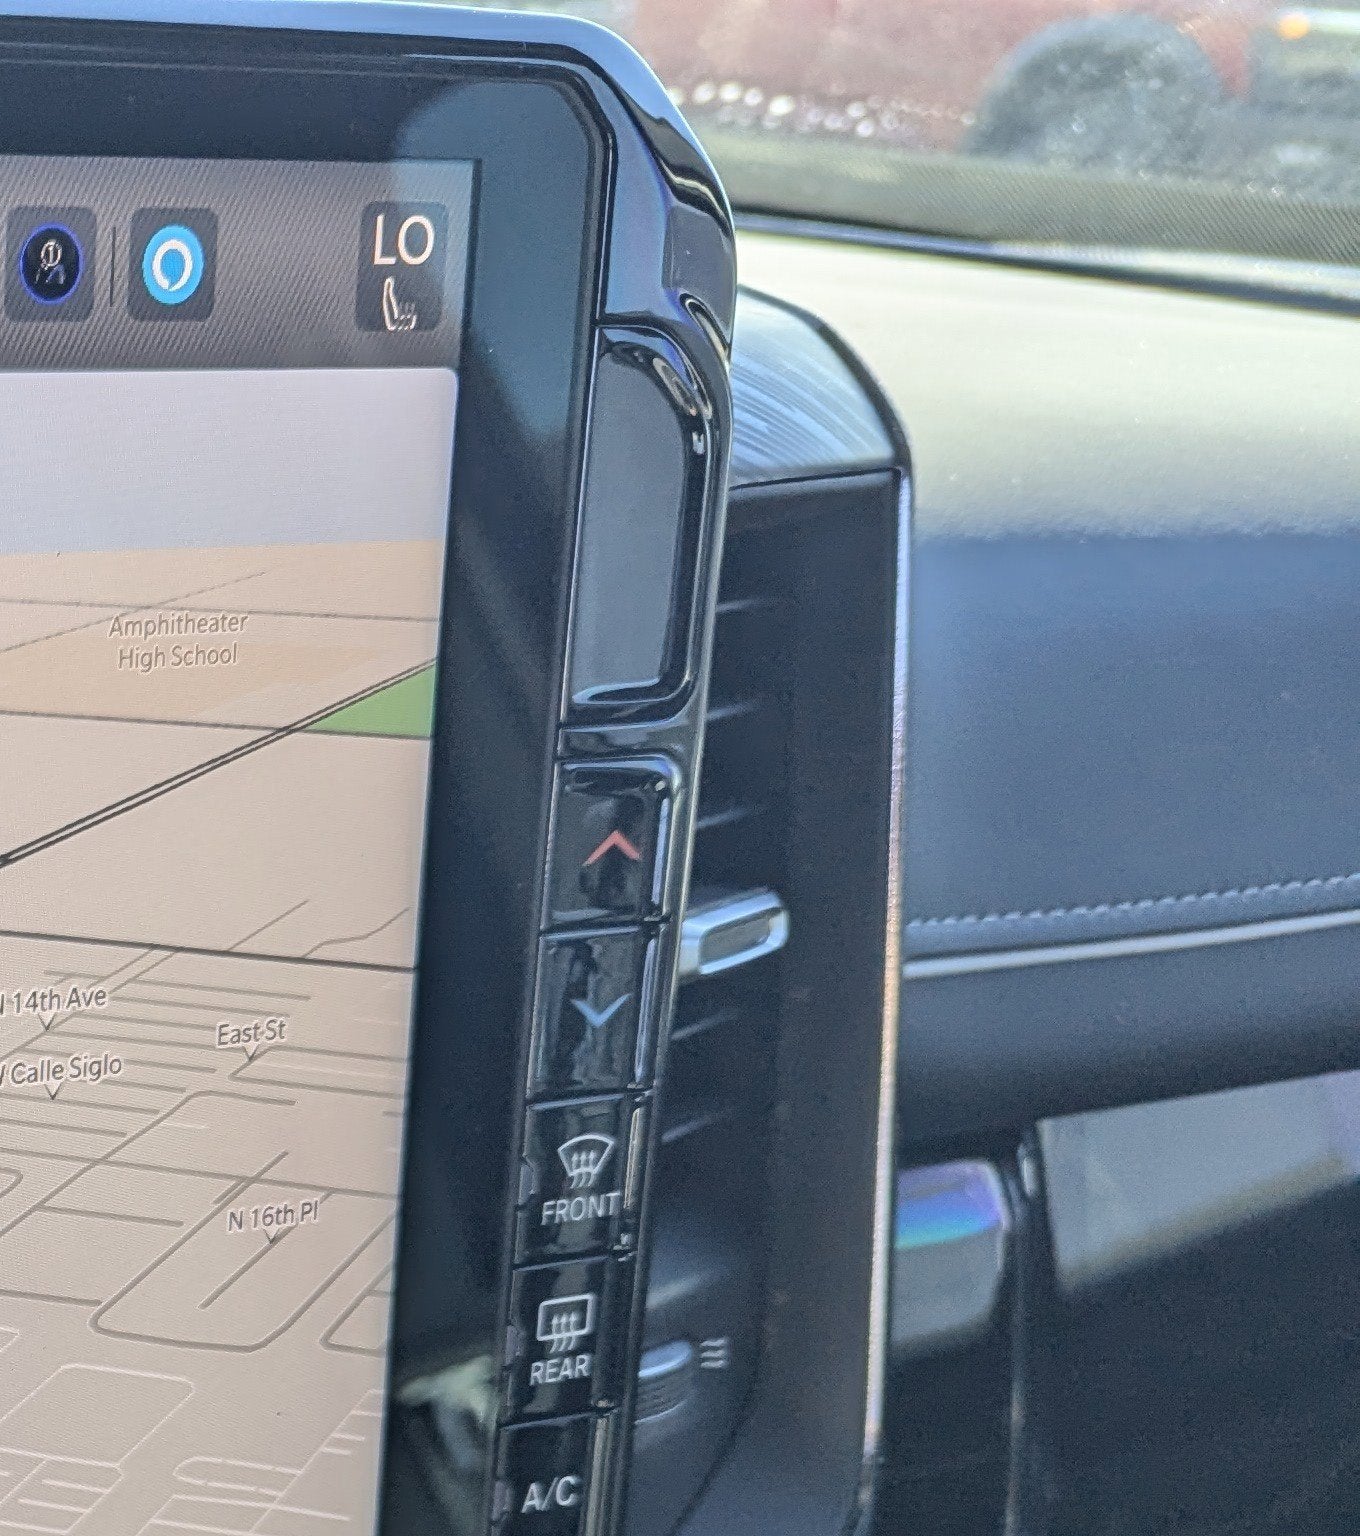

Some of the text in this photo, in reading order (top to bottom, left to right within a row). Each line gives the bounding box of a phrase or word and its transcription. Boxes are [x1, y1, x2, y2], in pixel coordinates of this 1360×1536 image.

[371, 213, 436, 268] LO
[108, 612, 249, 640] Amphitheater
[118, 642, 239, 674] High School
[10, 987, 62, 1014] 14th
[66, 985, 109, 1009] Ave
[216, 1018, 287, 1046] East St
[10, 1057, 66, 1086] Calle
[69, 1052, 124, 1086] Siglo
[227, 1199, 320, 1232] N 16th Pl
[540, 1190, 623, 1227] FRONT
[529, 1353, 592, 1387] REAR
[521, 1476, 581, 1514] A/C
